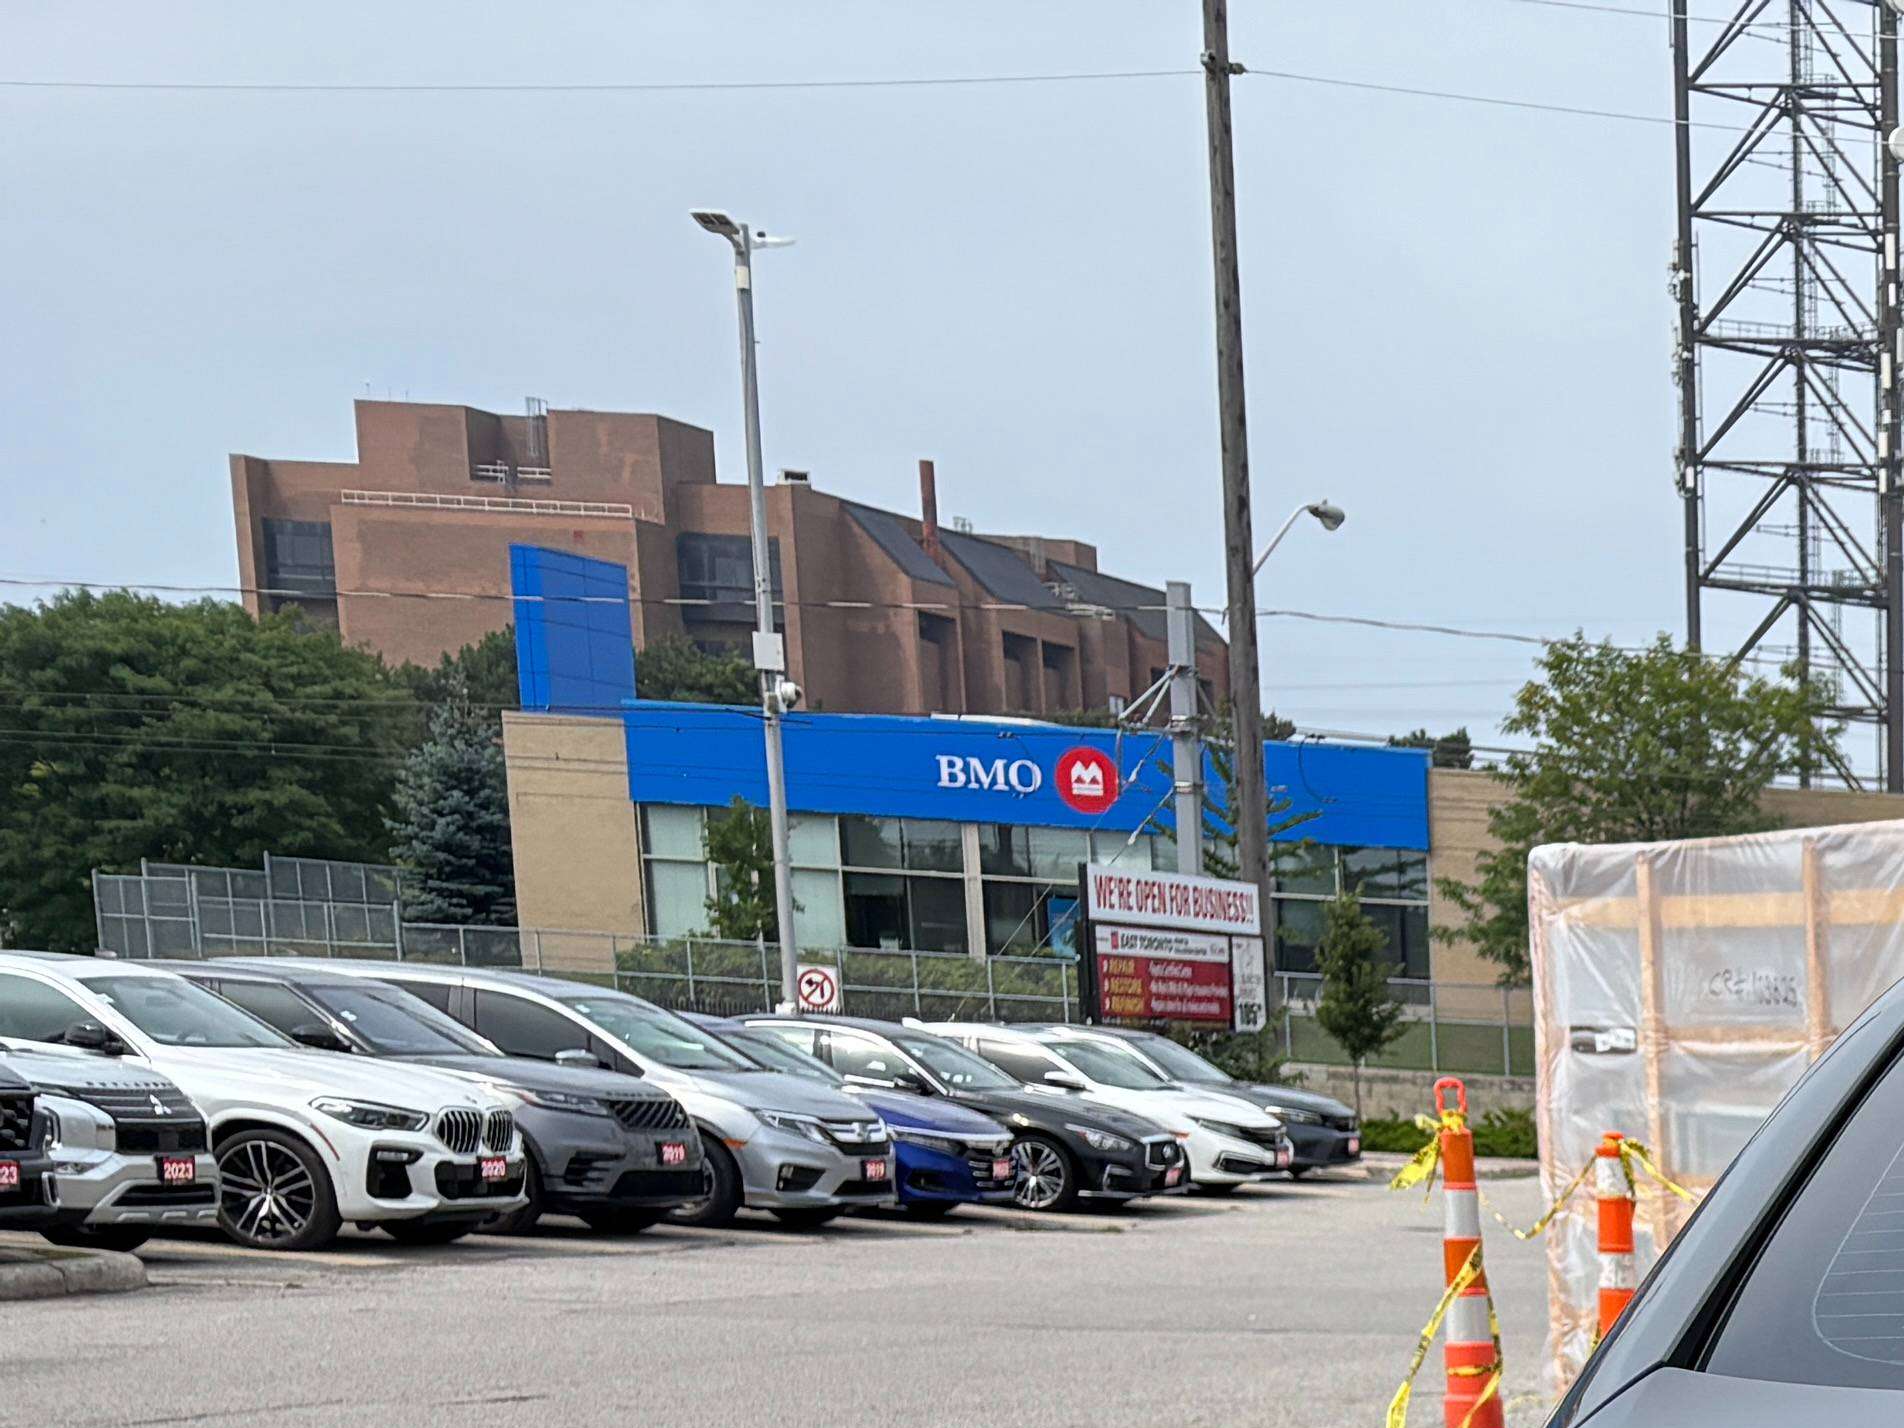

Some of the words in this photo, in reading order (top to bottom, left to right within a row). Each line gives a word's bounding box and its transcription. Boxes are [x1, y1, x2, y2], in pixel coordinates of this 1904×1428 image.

[935, 754, 1042, 793] BMO
[1136, 879, 1167, 915] OPEN
[1169, 883, 1191, 917] FOR
[163, 1162, 194, 1179] 2023
